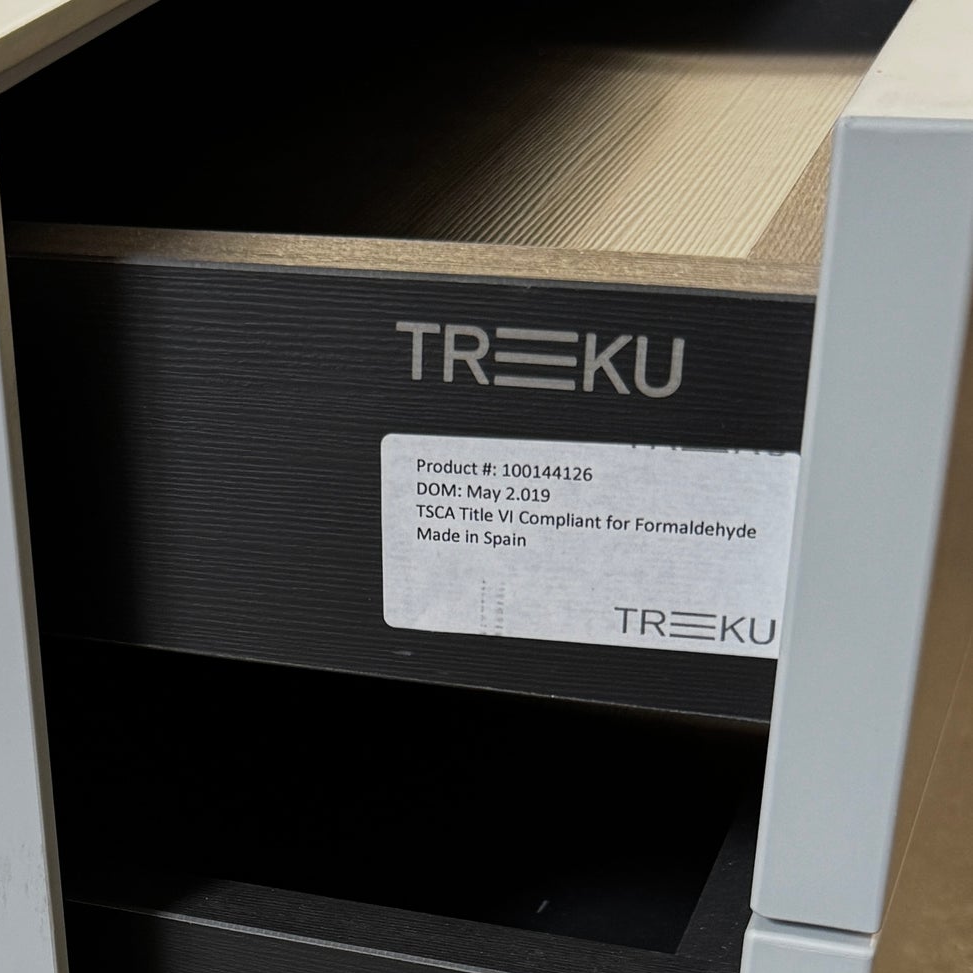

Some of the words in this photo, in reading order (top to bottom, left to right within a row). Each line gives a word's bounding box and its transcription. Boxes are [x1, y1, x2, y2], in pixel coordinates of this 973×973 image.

[396, 321, 685, 398] TREKU
[417, 459, 478, 475] Product
[483, 463, 497, 476] #:
[503, 463, 593, 481] 100144126
[417, 483, 462, 497] DOM:
[467, 486, 501, 502] May
[506, 487, 551, 502] 2.019
[417, 505, 455, 519] TSCA
[460, 507, 493, 522] Title
[499, 510, 514, 523] VI
[520, 511, 601, 530] Compliant
[606, 515, 630, 530] for
[636, 518, 757, 540] Formaldehyde
[417, 528, 460, 542] Made
[466, 530, 479, 544] in
[484, 532, 526, 547] Spain
[614, 607, 776, 645] TREKU
